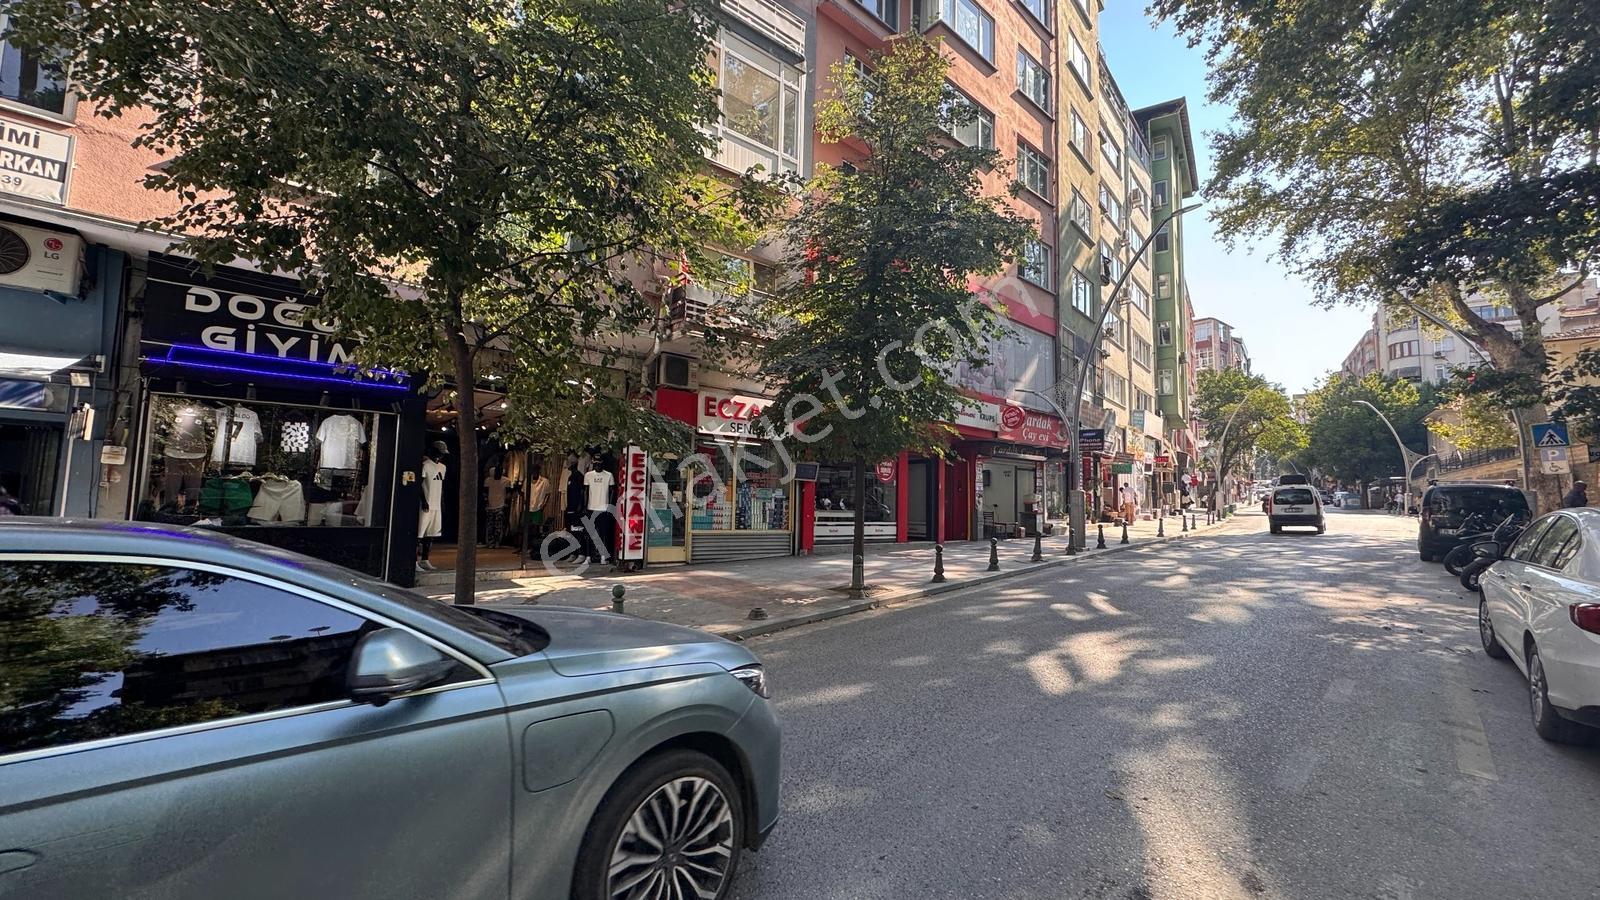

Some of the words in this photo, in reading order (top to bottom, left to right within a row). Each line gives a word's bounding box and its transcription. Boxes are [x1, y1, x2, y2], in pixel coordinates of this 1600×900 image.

[44, 251, 60, 260] LG
[185, 286, 339, 333] DOĞU
[1022, 429, 1036, 443] Çay
[1547, 450, 1560, 460] P
[628, 453, 646, 551] ECZANE
